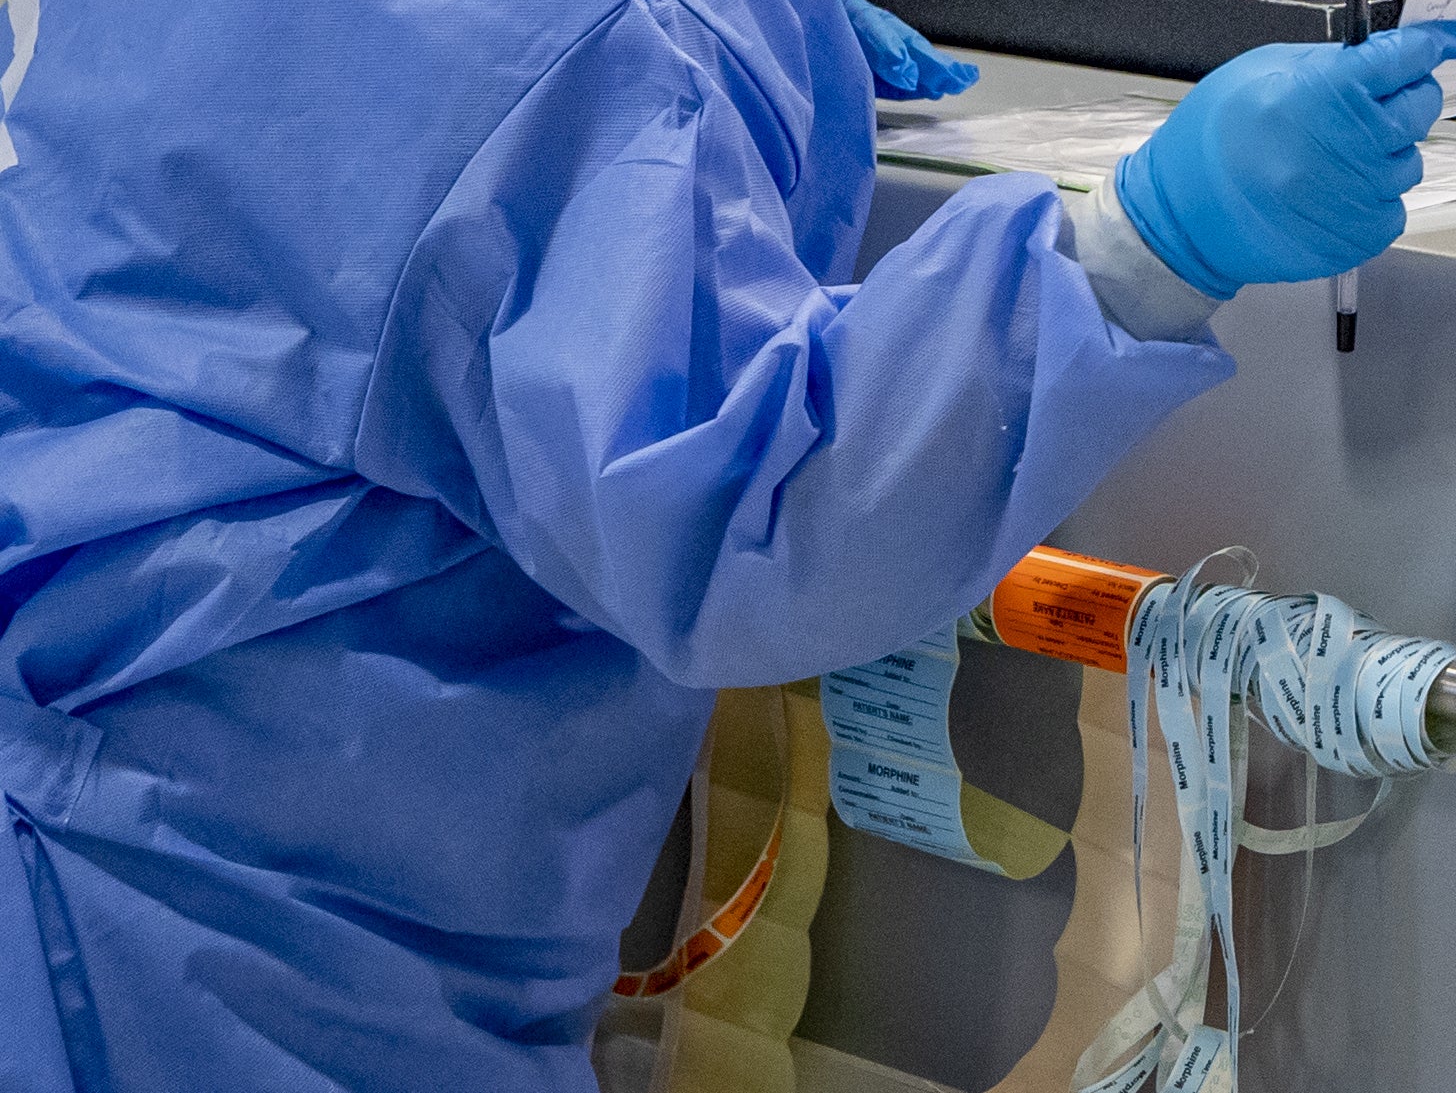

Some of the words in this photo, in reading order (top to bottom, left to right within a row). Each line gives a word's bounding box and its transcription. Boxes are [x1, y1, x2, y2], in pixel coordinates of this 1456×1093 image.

[1134, 600, 1156, 646] Morphine
[1209, 613, 1230, 660] Morphine
[1317, 613, 1333, 657] Morphine
[880, 654, 916, 671] PHINE
[1160, 638, 1169, 688] Morphine
[1378, 640, 1422, 666] Morphine
[1407, 646, 1443, 681] Morphine
[1279, 678, 1307, 725] Morphine
[1331, 685, 1342, 736] Morphine
[1207, 715, 1216, 764] Morphine
[1312, 704, 1324, 749] Morphine
[867, 762, 920, 787] MORPHINE
[1173, 742, 1188, 790] Morphine
[1174, 1046, 1201, 1090] Morphine
